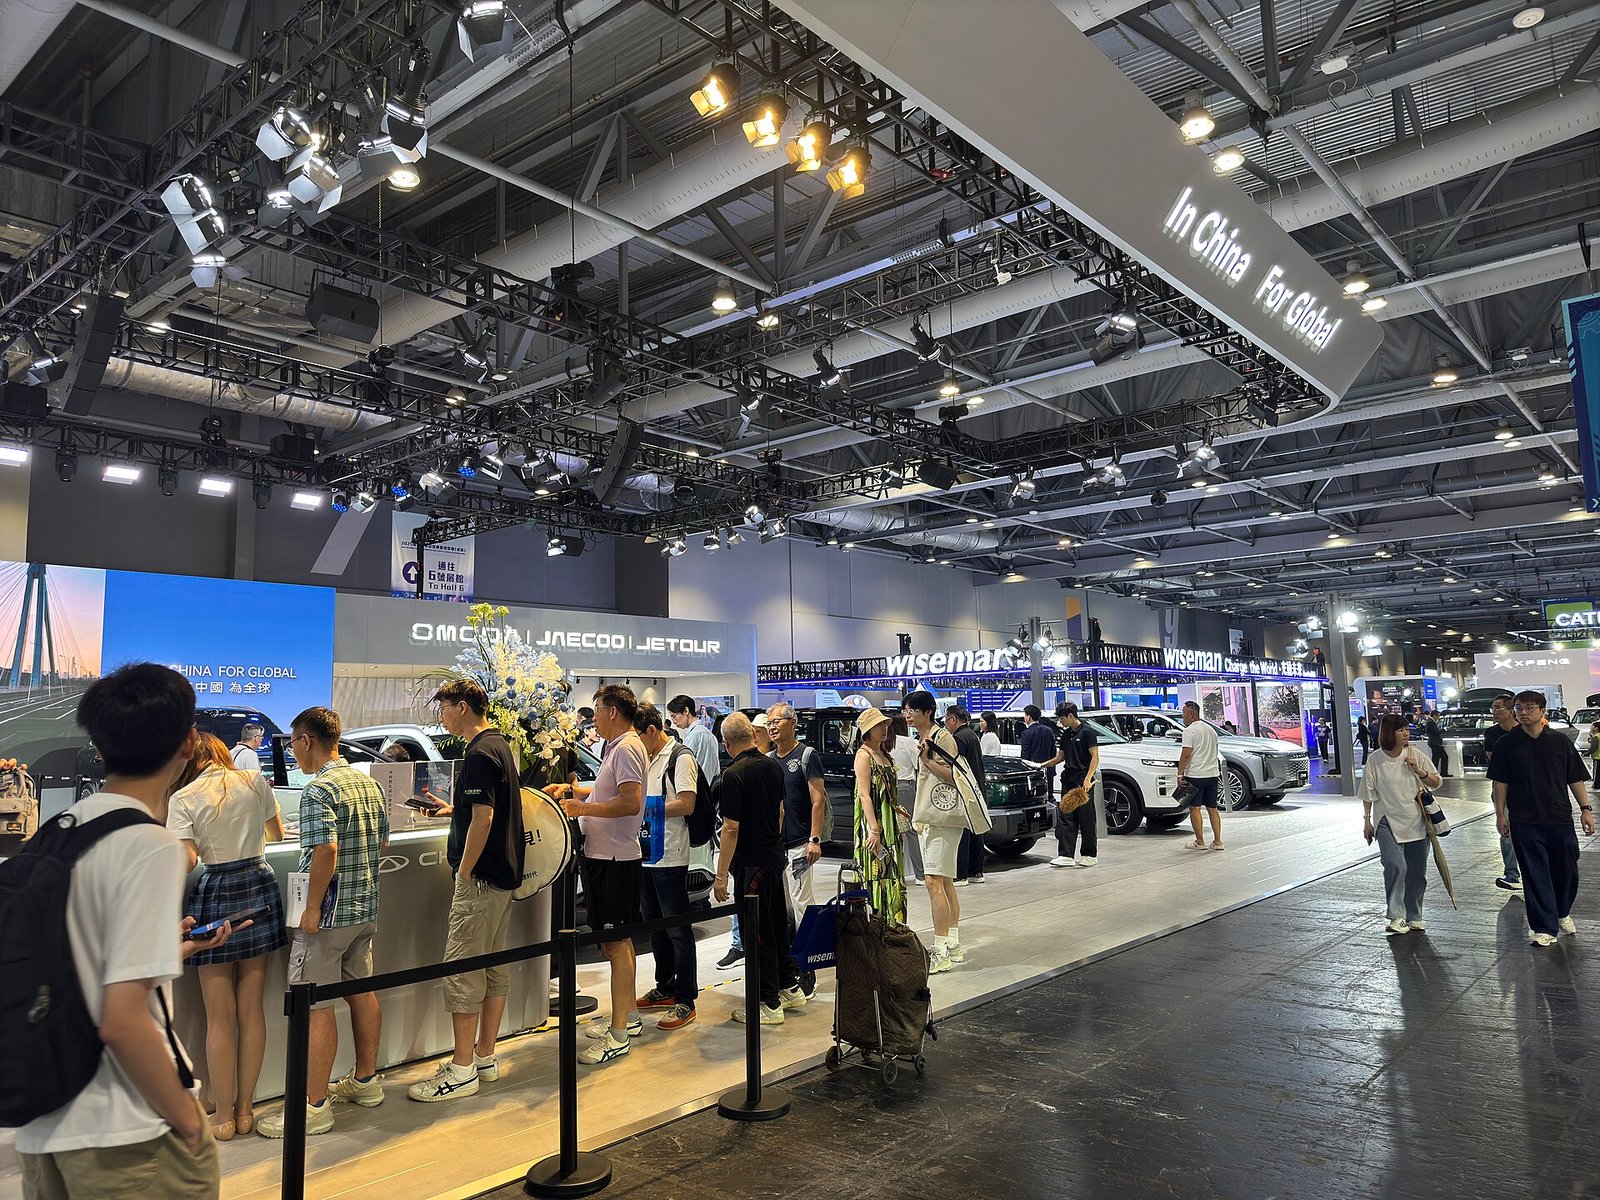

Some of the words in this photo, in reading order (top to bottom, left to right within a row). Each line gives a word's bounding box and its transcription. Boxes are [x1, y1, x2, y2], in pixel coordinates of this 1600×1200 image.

[1164, 186, 1198, 239] In
[1191, 210, 1253, 284] China
[1256, 264, 1294, 313] For
[1286, 291, 1343, 350] Global
[437, 561, 456, 572] 通往
[428, 582, 439, 590] To
[535, 630, 625, 649] JAECOO
[635, 636, 721, 654] JETOUR
[1163, 648, 1223, 673] wiseman
[1224, 657, 1248, 676] Charge
[1249, 660, 1260, 674] the
[1260, 660, 1279, 676] World
[218, 666, 245, 677] FOR
[247, 666, 297, 678] GLOBAL
[190, 681, 223, 694] 中國
[228, 682, 271, 694] 為全球
